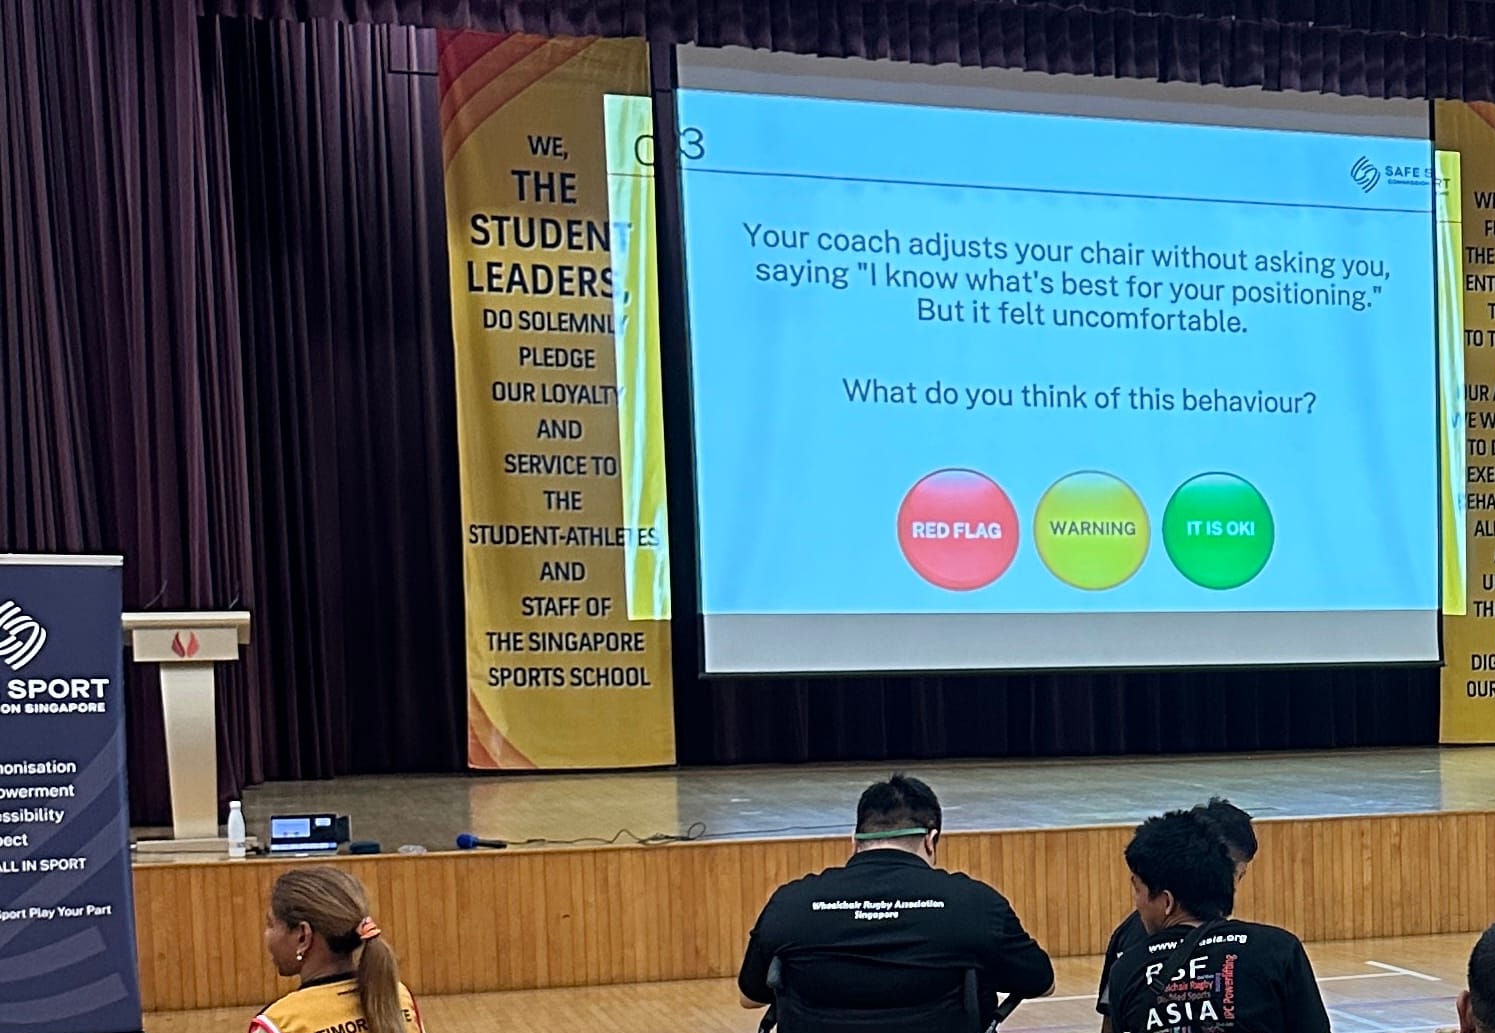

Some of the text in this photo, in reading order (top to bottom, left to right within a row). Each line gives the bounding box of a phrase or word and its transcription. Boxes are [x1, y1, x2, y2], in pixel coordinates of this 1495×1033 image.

[528, 135, 568, 160] WE,
[1384, 165, 1420, 178] SAFE
[511, 169, 577, 204] THE
[470, 213, 633, 252] STUDENT
[743, 222, 1391, 281] Your coach adjusts your chair without asking you,
[1466, 246, 1495, 265] THE
[467, 260, 630, 305] LEADERS,
[755, 258, 1383, 312] saying "I know what's best for your positioning."
[483, 308, 628, 335] DO SOLEMNLY
[918, 297, 1249, 334] But it felt uncomfortable.
[1464, 329, 1484, 347] TO
[519, 346, 596, 369] PLEDGE
[492, 381, 625, 405] OUR LOYALTY
[842, 377, 1318, 416] What do you think of this behaviour?
[537, 419, 582, 440] AND
[1467, 438, 1487, 456] TO
[504, 454, 617, 477] SERVICE TO
[544, 490, 582, 511] THE
[912, 521, 1003, 540] RED FLAG
[1049, 520, 1137, 537] WARNING
[1187, 520, 1203, 537] IT
[1206, 520, 1223, 536] IS
[540, 561, 586, 582] AND
[522, 596, 612, 617] STAFF OF
[486, 632, 645, 652] THE SINGAPORE
[488, 667, 651, 687] SPORTS SCHOOL
[8, 678, 110, 699] SPORT
[24, 702, 106, 714] SINGAPORE
[0, 760, 77, 775] onisation
[0, 807, 65, 824] ssibility
[0, 858, 87, 873] LL IN SPORT
[0, 904, 112, 921] port Play Your Part
[854, 910, 899, 920] Singapore
[863, 900, 893, 911] Rugby
[1146, 999, 1219, 1030] ASIA
